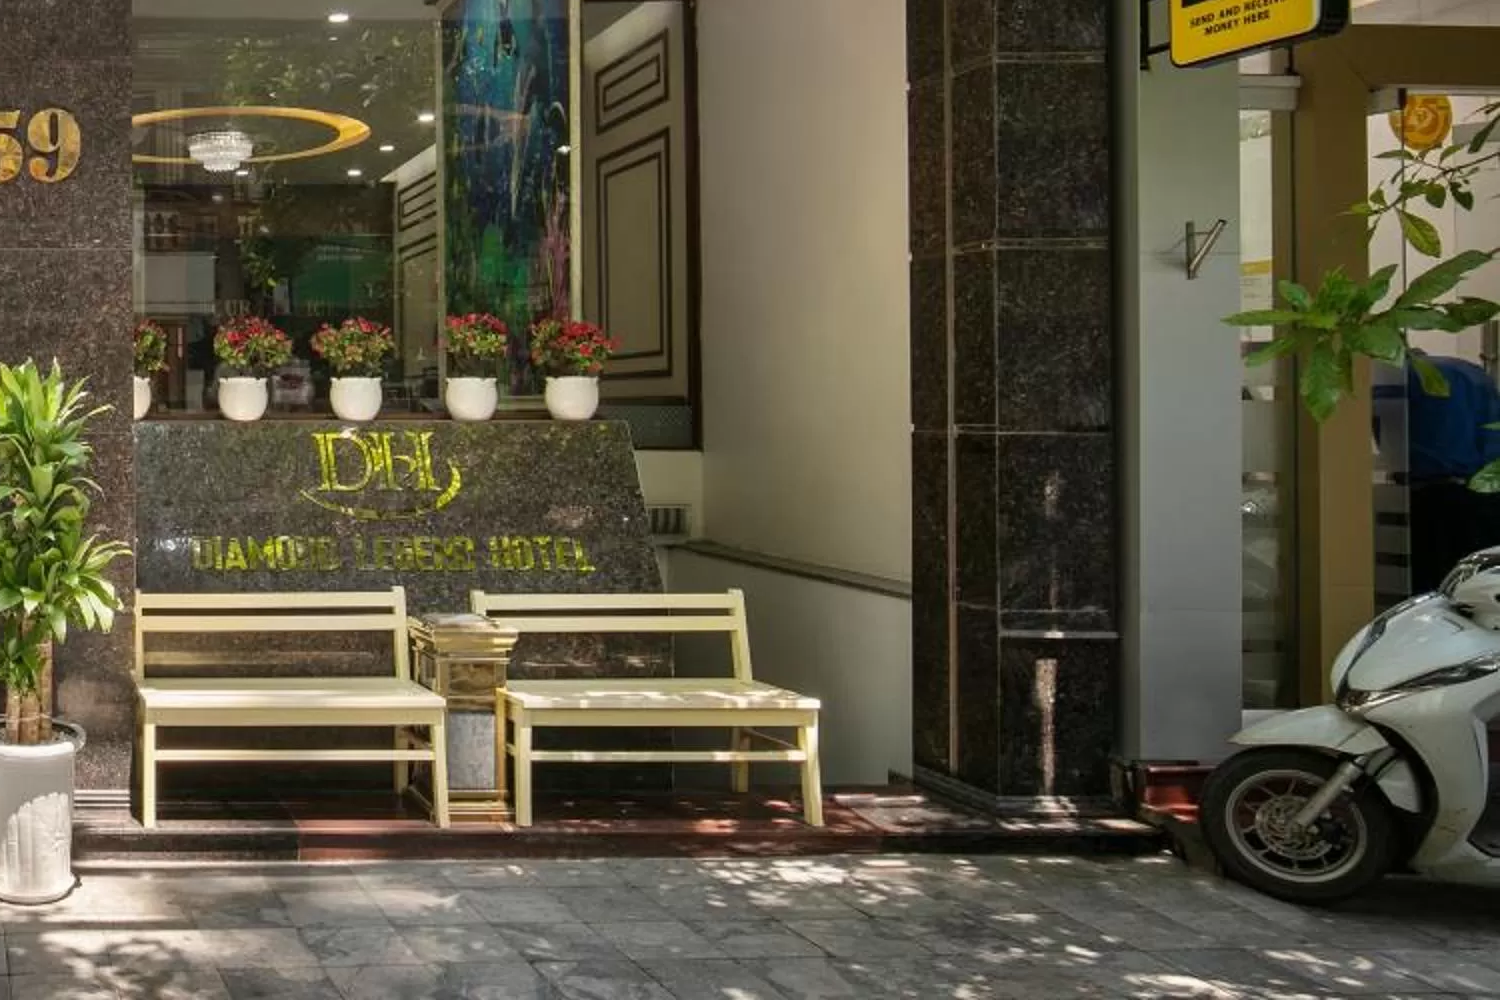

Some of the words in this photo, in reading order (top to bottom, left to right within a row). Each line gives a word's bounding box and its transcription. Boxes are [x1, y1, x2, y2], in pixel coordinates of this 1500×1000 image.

[1190, 12, 1215, 28] SEND
[1219, 5, 1241, 19] AND
[1204, 19, 1239, 35] MONEY
[1243, 9, 1270, 25] HERE
[191, 534, 342, 571] DIAMOND
[487, 535, 597, 574] HOTEL
